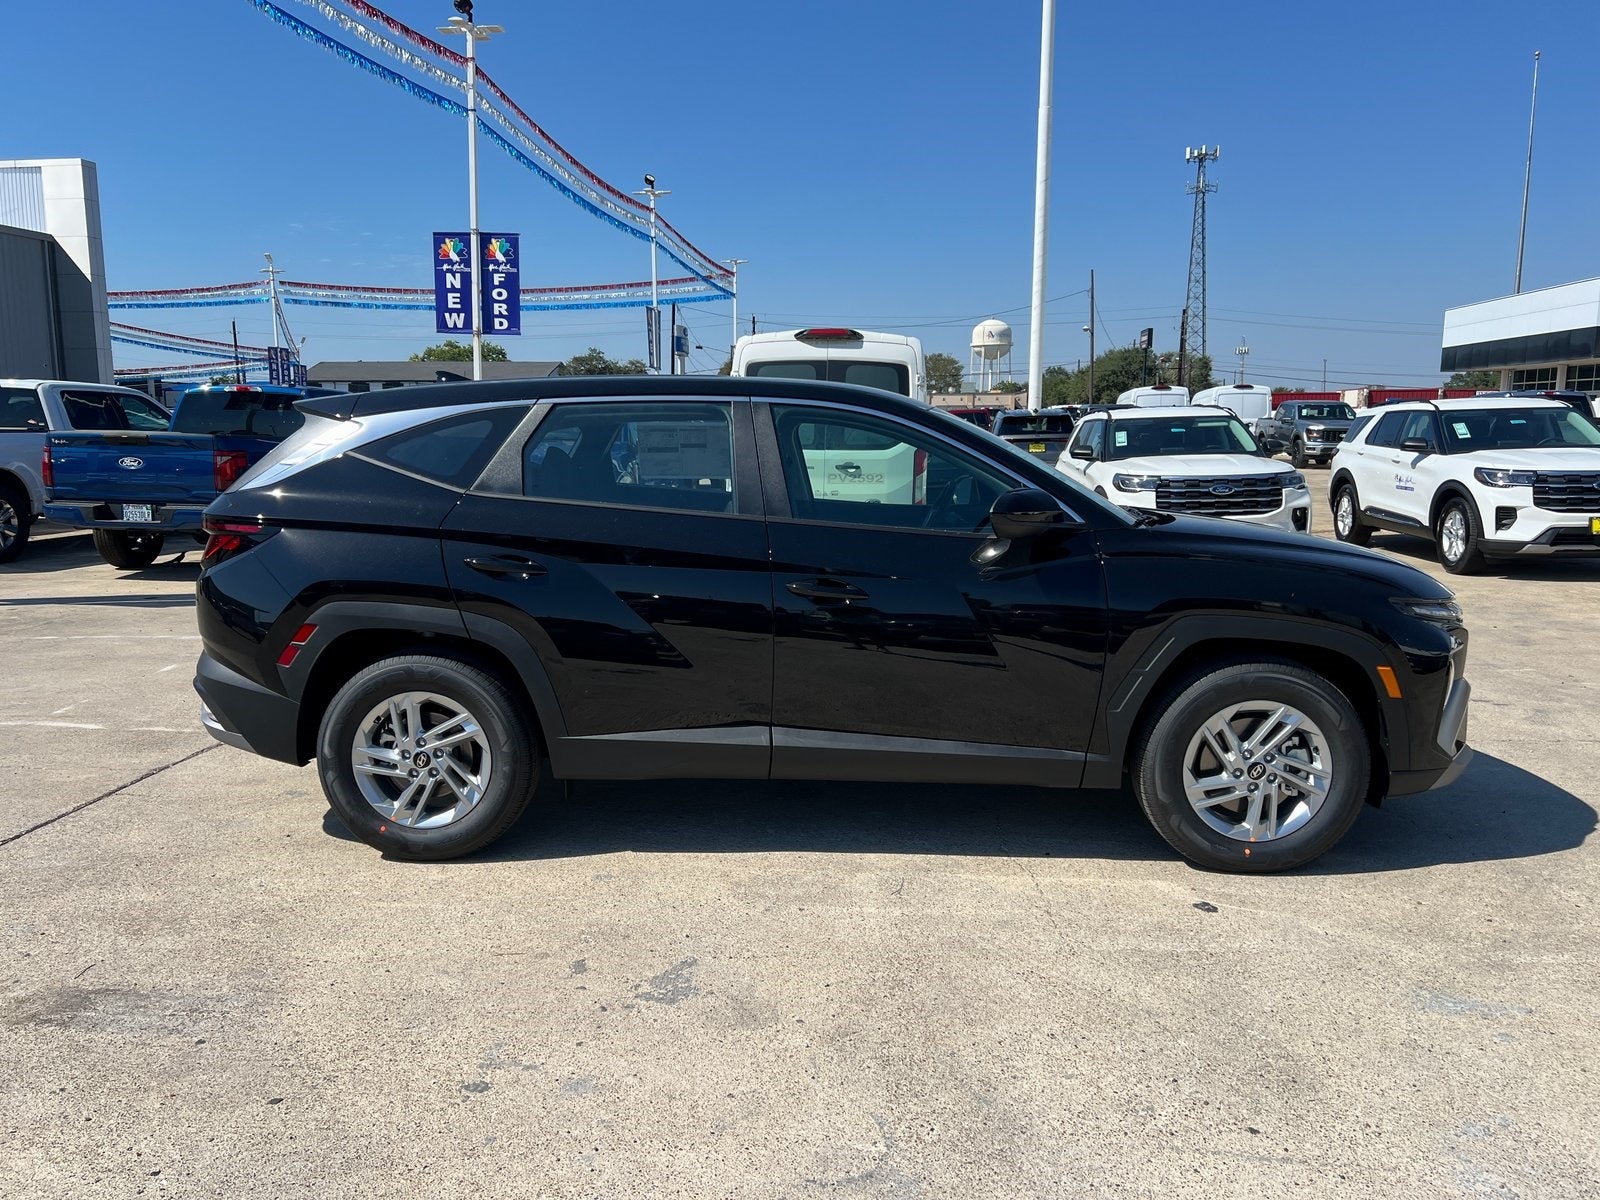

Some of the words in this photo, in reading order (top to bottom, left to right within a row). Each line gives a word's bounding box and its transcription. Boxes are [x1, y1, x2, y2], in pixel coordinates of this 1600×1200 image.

[444, 273, 465, 328] NEW
[491, 273, 509, 330] FORD
[828, 473, 884, 483] PV2592
